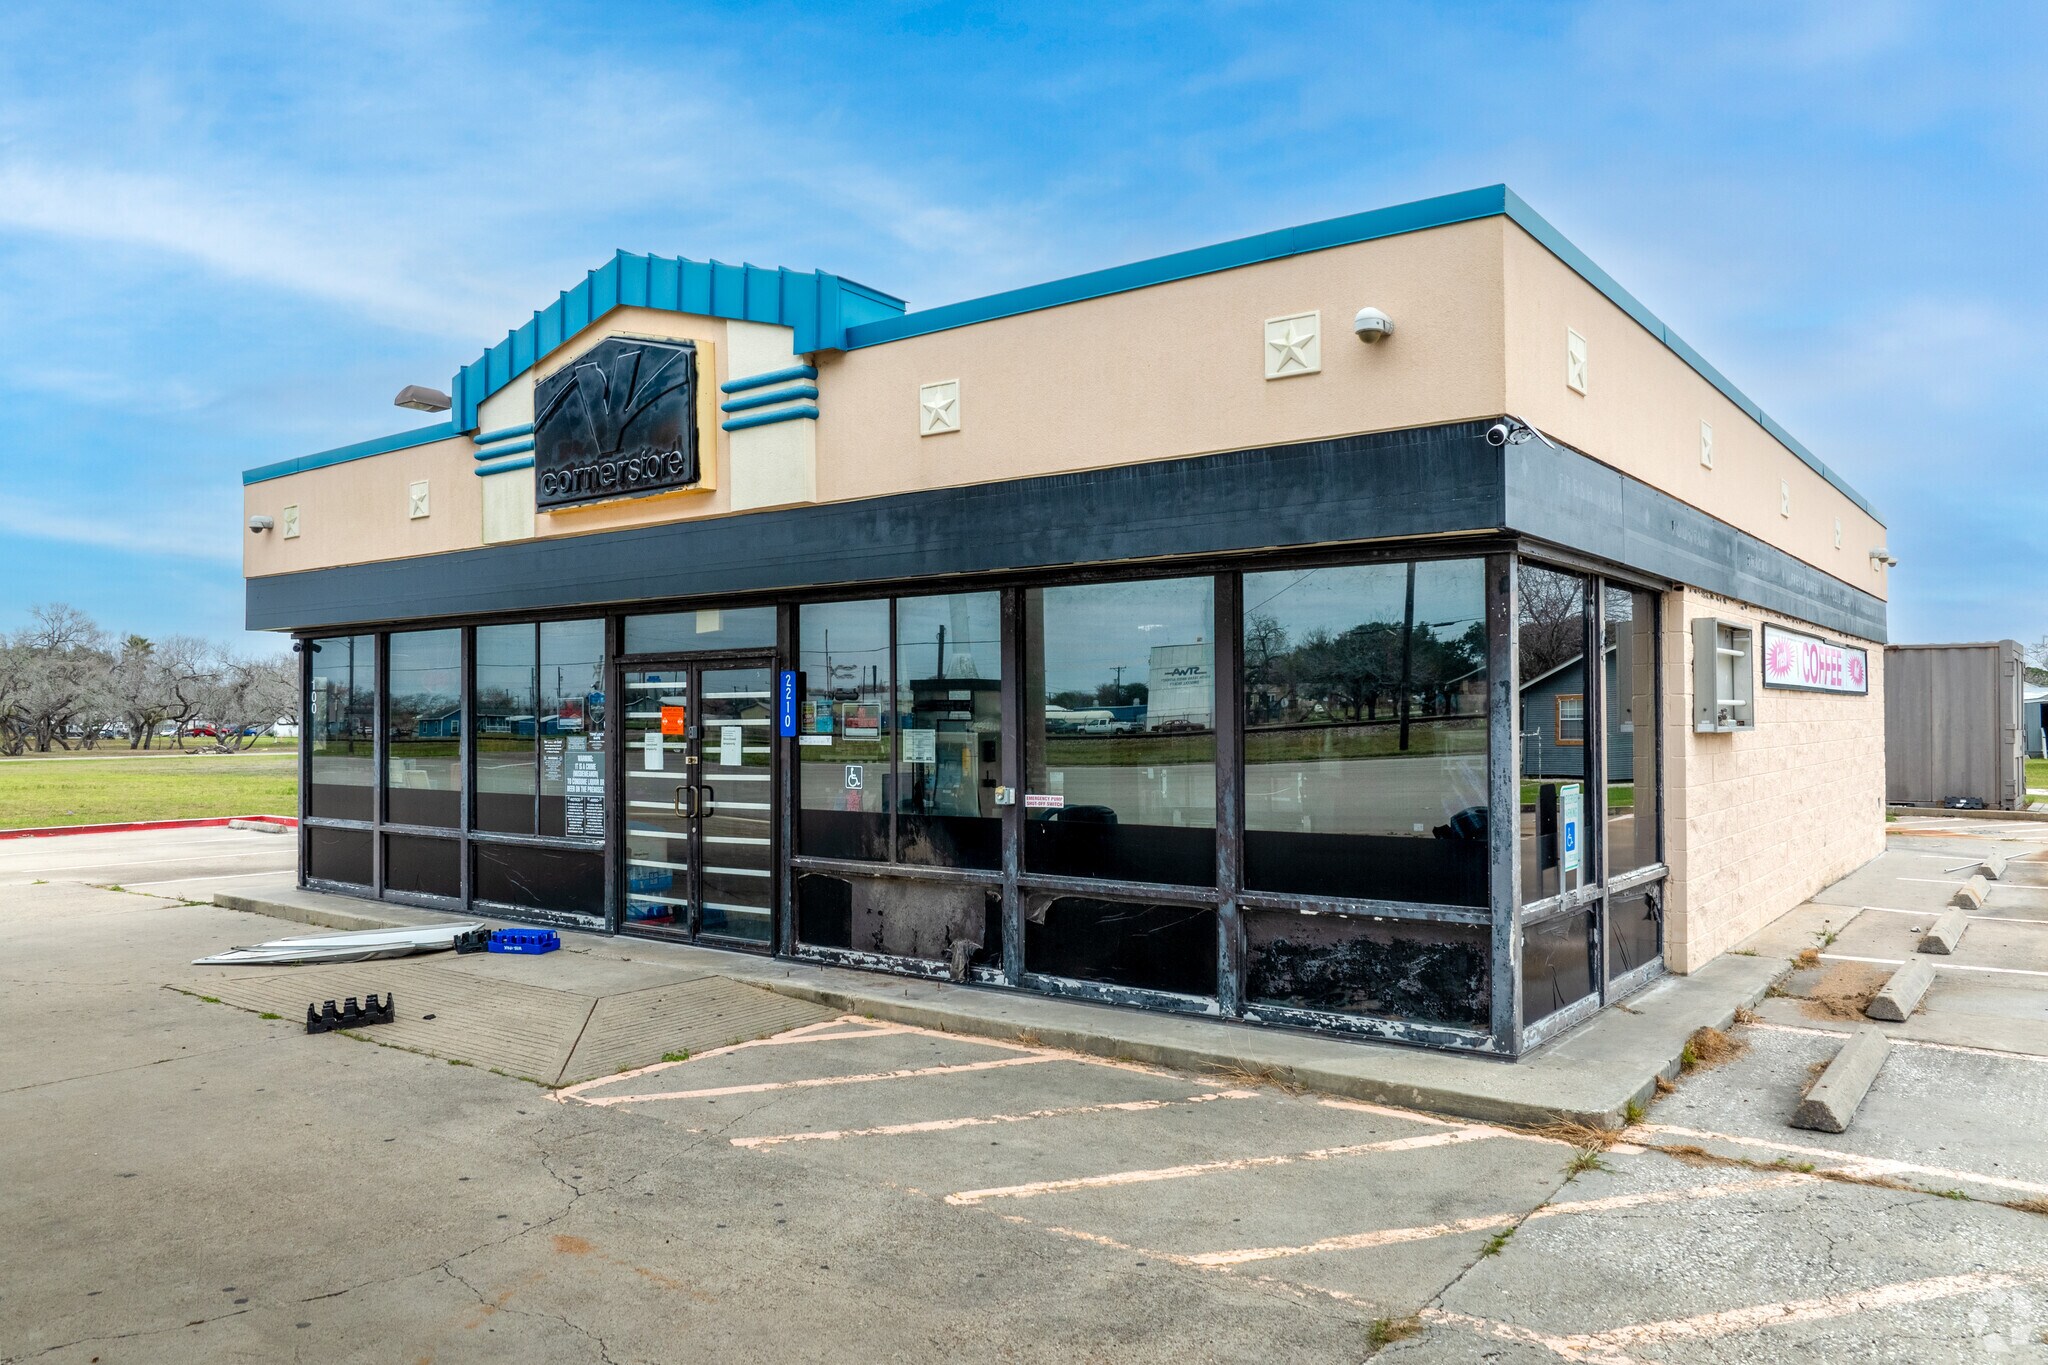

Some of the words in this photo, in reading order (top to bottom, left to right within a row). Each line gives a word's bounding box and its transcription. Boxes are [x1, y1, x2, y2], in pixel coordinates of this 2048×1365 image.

[541, 450, 683, 496] cornerstore
[1803, 642, 1841, 686] COFFEE
[784, 674, 792, 728] 2210
